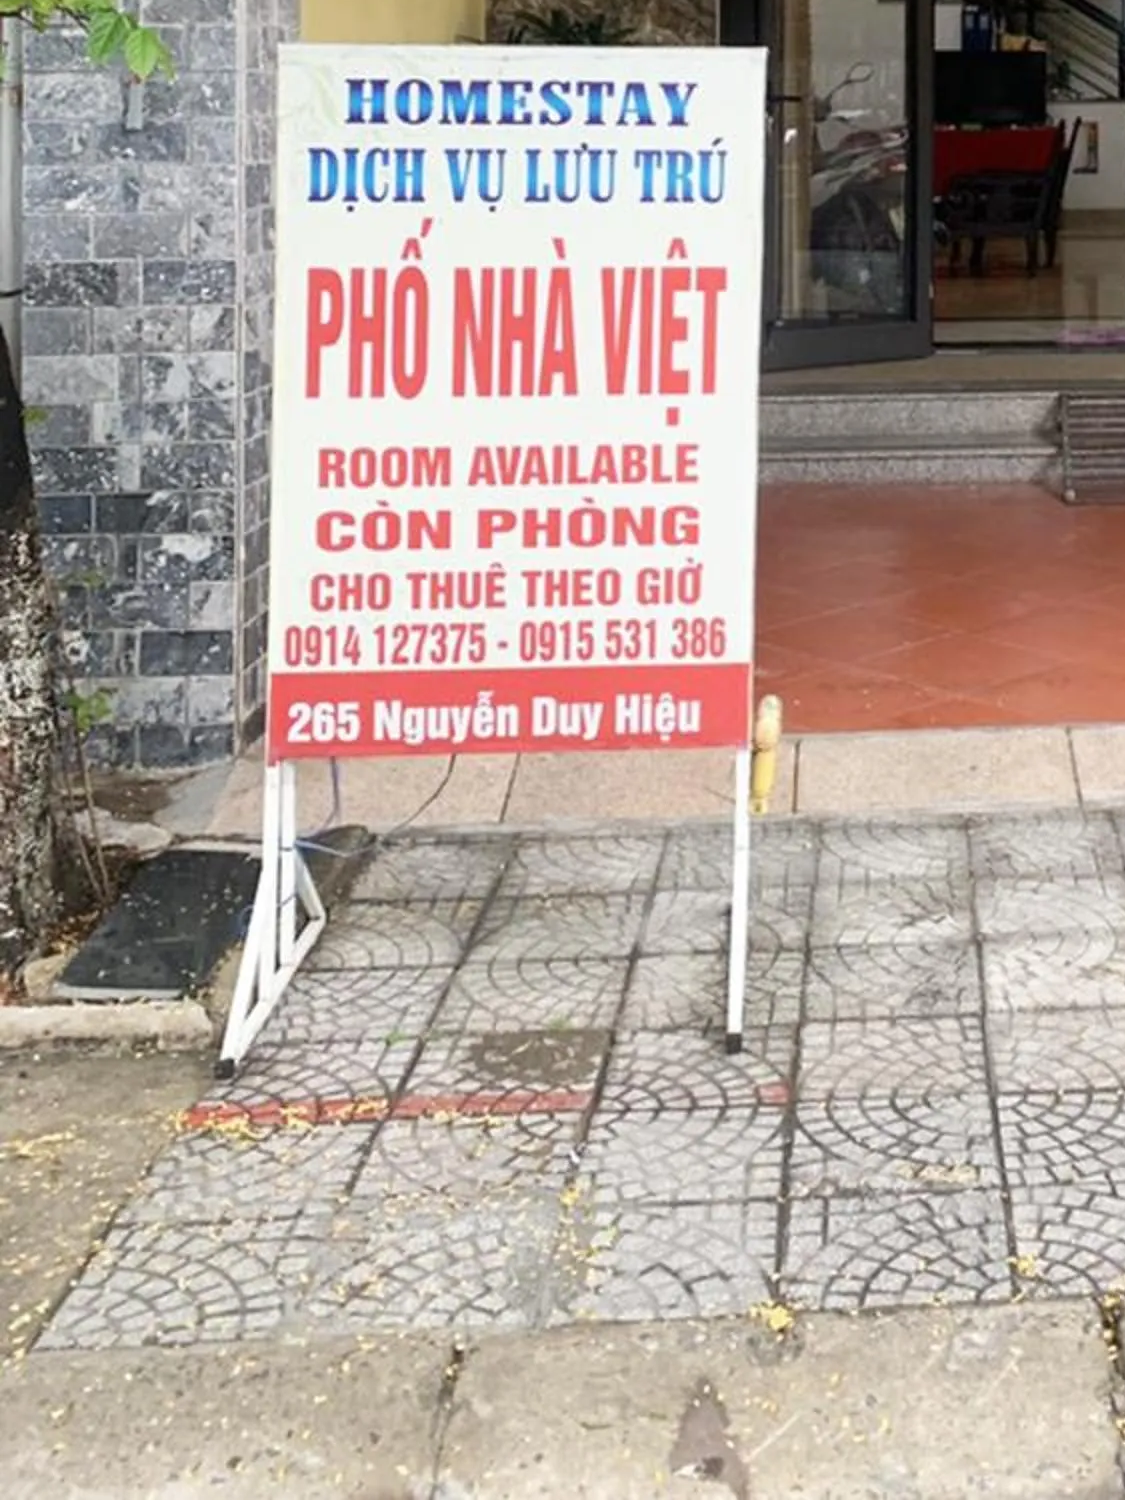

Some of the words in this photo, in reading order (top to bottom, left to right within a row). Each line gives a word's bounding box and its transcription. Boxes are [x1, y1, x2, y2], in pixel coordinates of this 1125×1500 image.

[345, 78, 698, 127] HOMESTAY
[307, 147, 426, 213] DỊCH
[444, 148, 507, 213] VỤ
[524, 143, 617, 203] LƯU
[634, 138, 728, 204] TRÚ
[305, 217, 433, 400] PHỐ
[452, 237, 578, 398] NHÀ
[600, 238, 728, 426] VIỆT
[318, 447, 452, 489] ROOM
[467, 443, 699, 486] AVAILABLE
[315, 500, 452, 552] CÒN
[476, 498, 700, 549] PHÒNG
[309, 573, 393, 612] CHO
[406, 562, 507, 610] THUÊ
[521, 568, 622, 607] THEO
[636, 558, 703, 605] GIỜ
[284, 625, 361, 668] 0914
[373, 623, 487, 666] 127375
[519, 621, 595, 663] 0915
[605, 619, 657, 661] 531
[671, 617, 727, 659] 386
[287, 701, 361, 743] 265
[373, 691, 519, 745] Nguyễn
[531, 696, 604, 741] Duy
[614, 692, 702, 742] Hiệu
